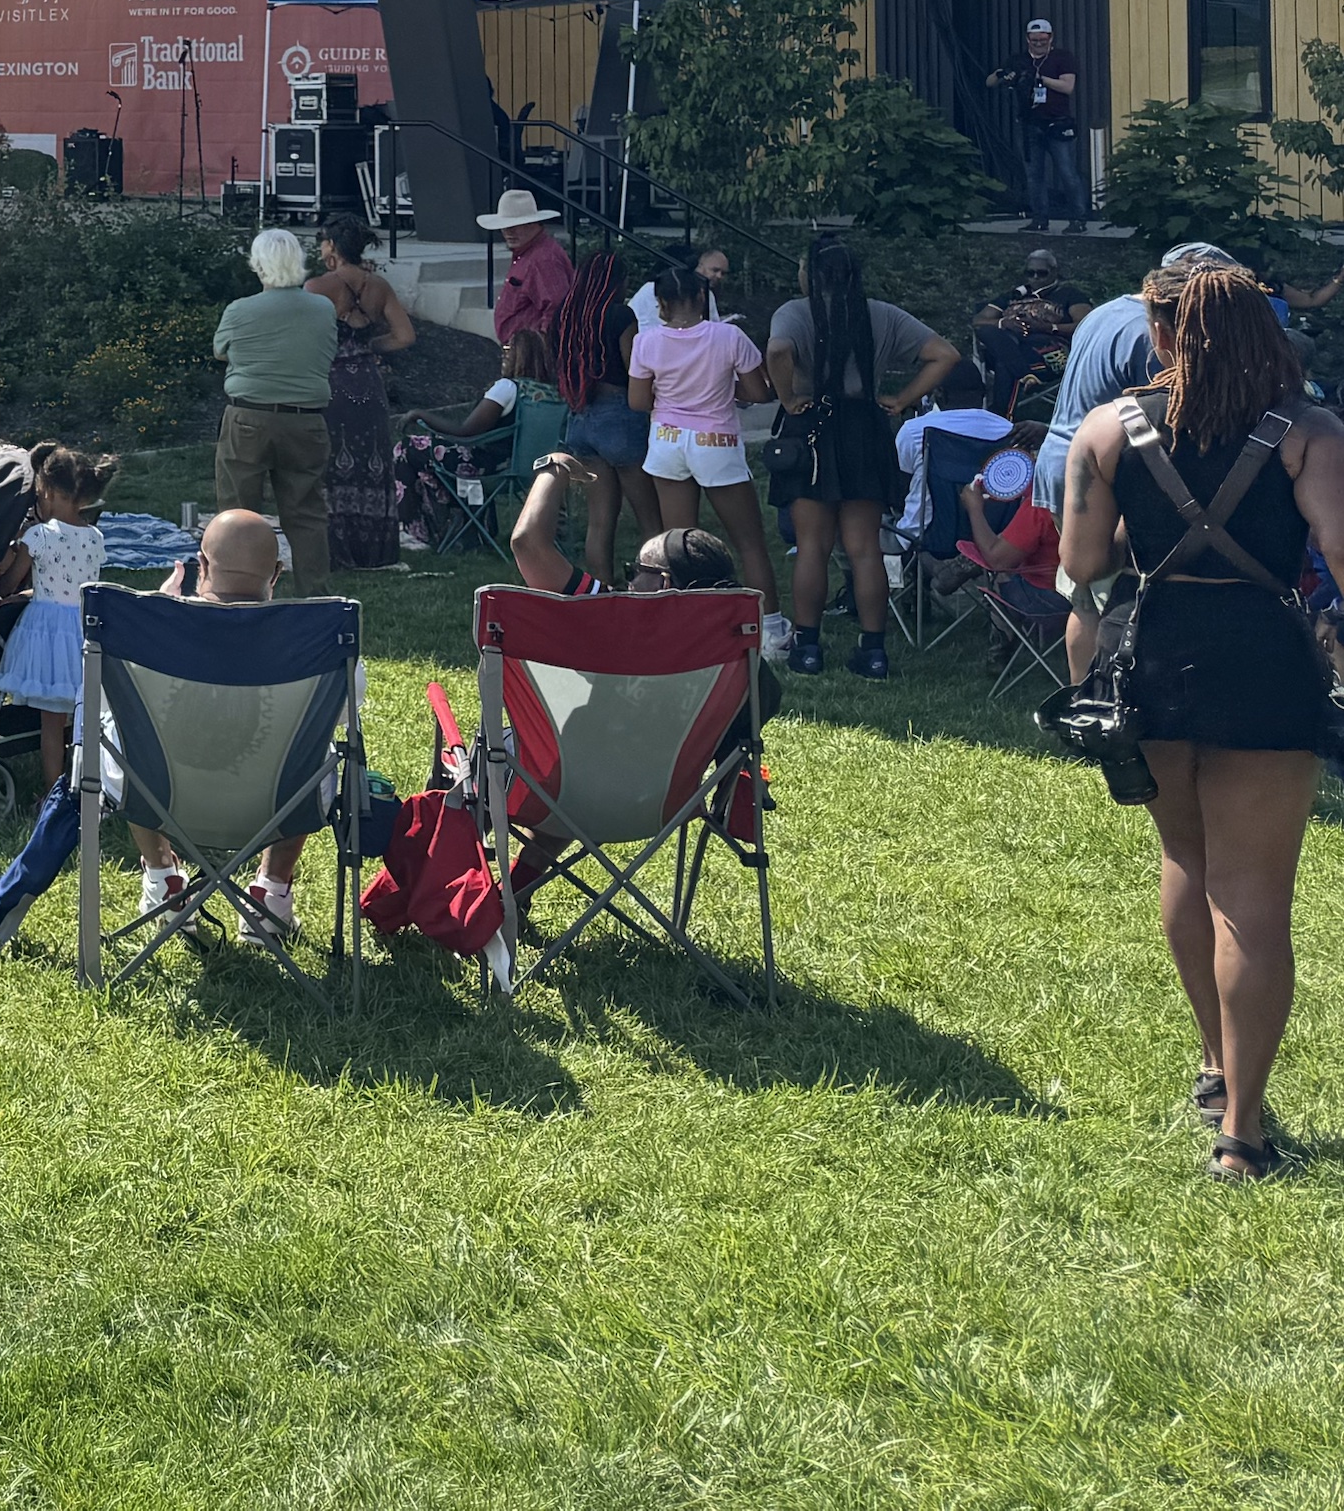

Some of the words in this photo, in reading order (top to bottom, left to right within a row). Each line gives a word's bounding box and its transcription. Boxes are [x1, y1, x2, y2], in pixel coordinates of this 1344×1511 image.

[160, 7, 170, 16] IN
[184, 7, 204, 16] FOR
[318, 47, 371, 61] GUIDE
[142, 63, 193, 90] Bank
[656, 426, 681, 443] PIT
[695, 431, 738, 447] CREW
